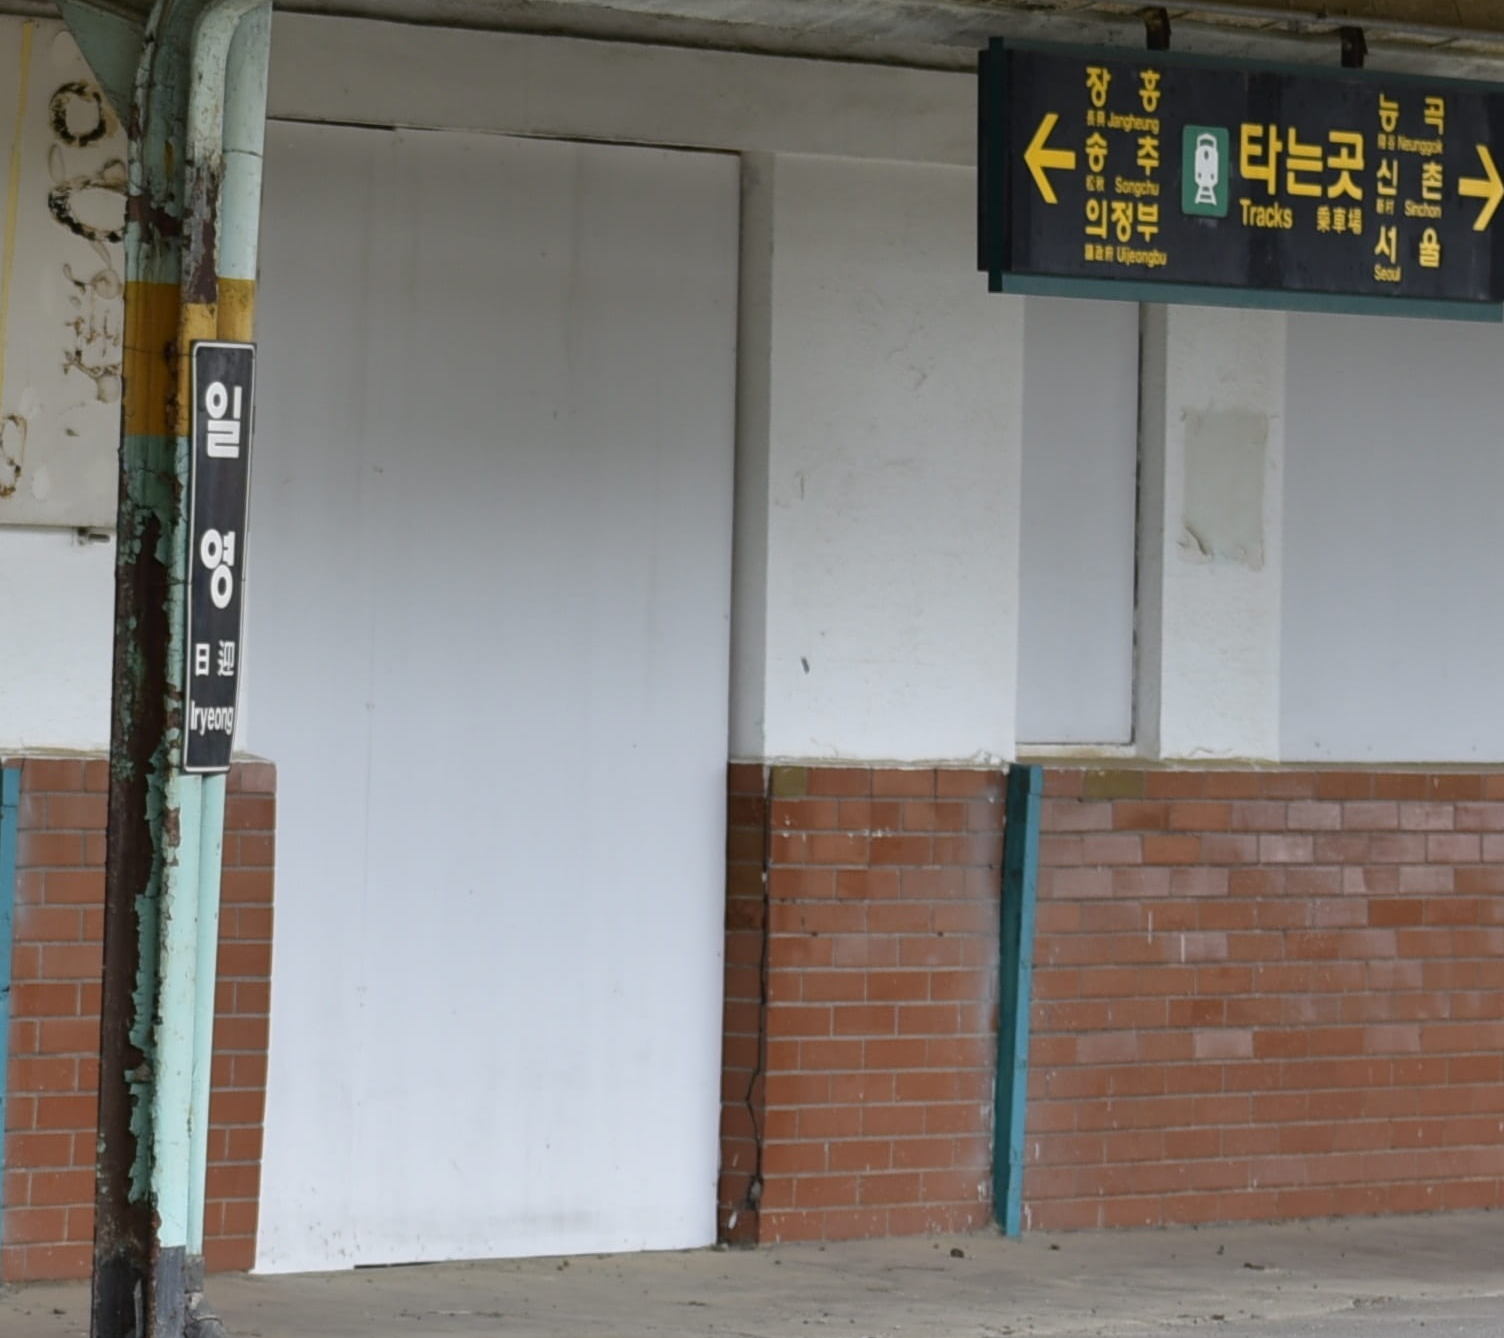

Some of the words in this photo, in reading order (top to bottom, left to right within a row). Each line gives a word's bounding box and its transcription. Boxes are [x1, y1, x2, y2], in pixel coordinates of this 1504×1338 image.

[1106, 112, 1160, 135] Jangheung
[1397, 134, 1444, 157] Neunggok
[1239, 123, 1365, 201] 타는곳
[1114, 176, 1160, 198] Songchu
[1084, 198, 1159, 243] 의정부
[1239, 198, 1293, 230] Tracks
[1404, 199, 1442, 219] Sinchon
[1116, 245, 1168, 269] Uijeongbu
[1374, 263, 1402, 282] Seoul
[190, 699, 234, 737] Iryeong
